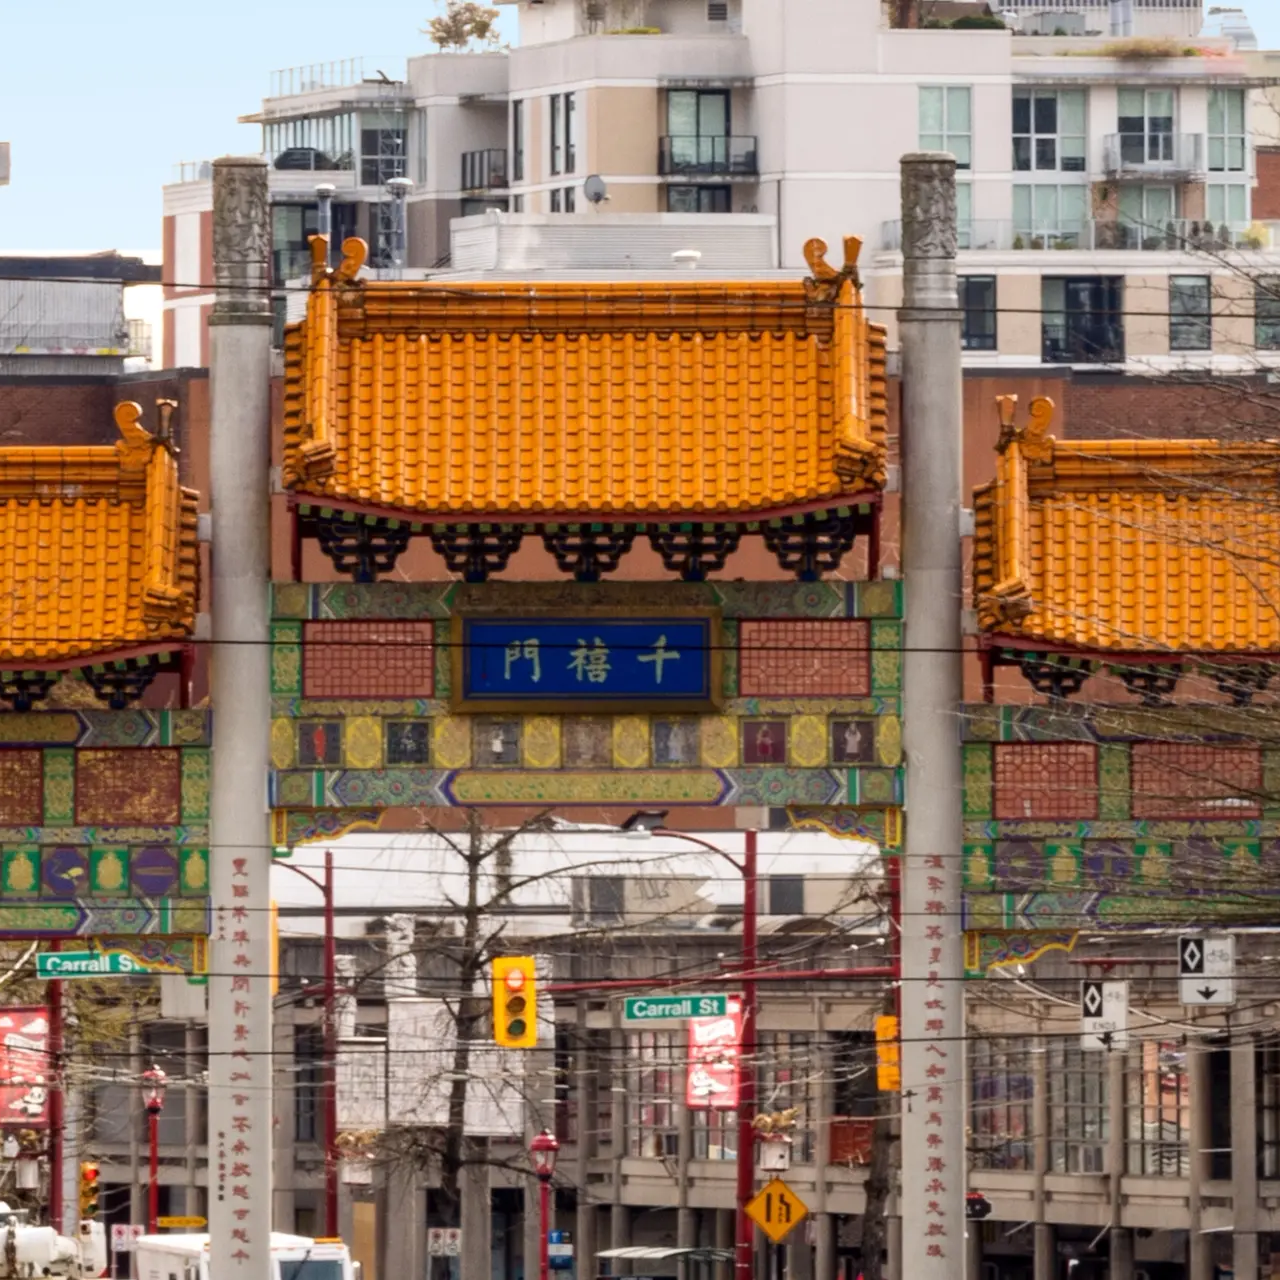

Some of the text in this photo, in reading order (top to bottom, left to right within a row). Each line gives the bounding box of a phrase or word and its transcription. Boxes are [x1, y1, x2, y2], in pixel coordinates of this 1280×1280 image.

[503, 634, 681, 685] 千禧門
[46, 953, 110, 975] Carrall
[633, 999, 719, 1017] Carrall St
[1092, 1021, 1117, 1030] ENDS
